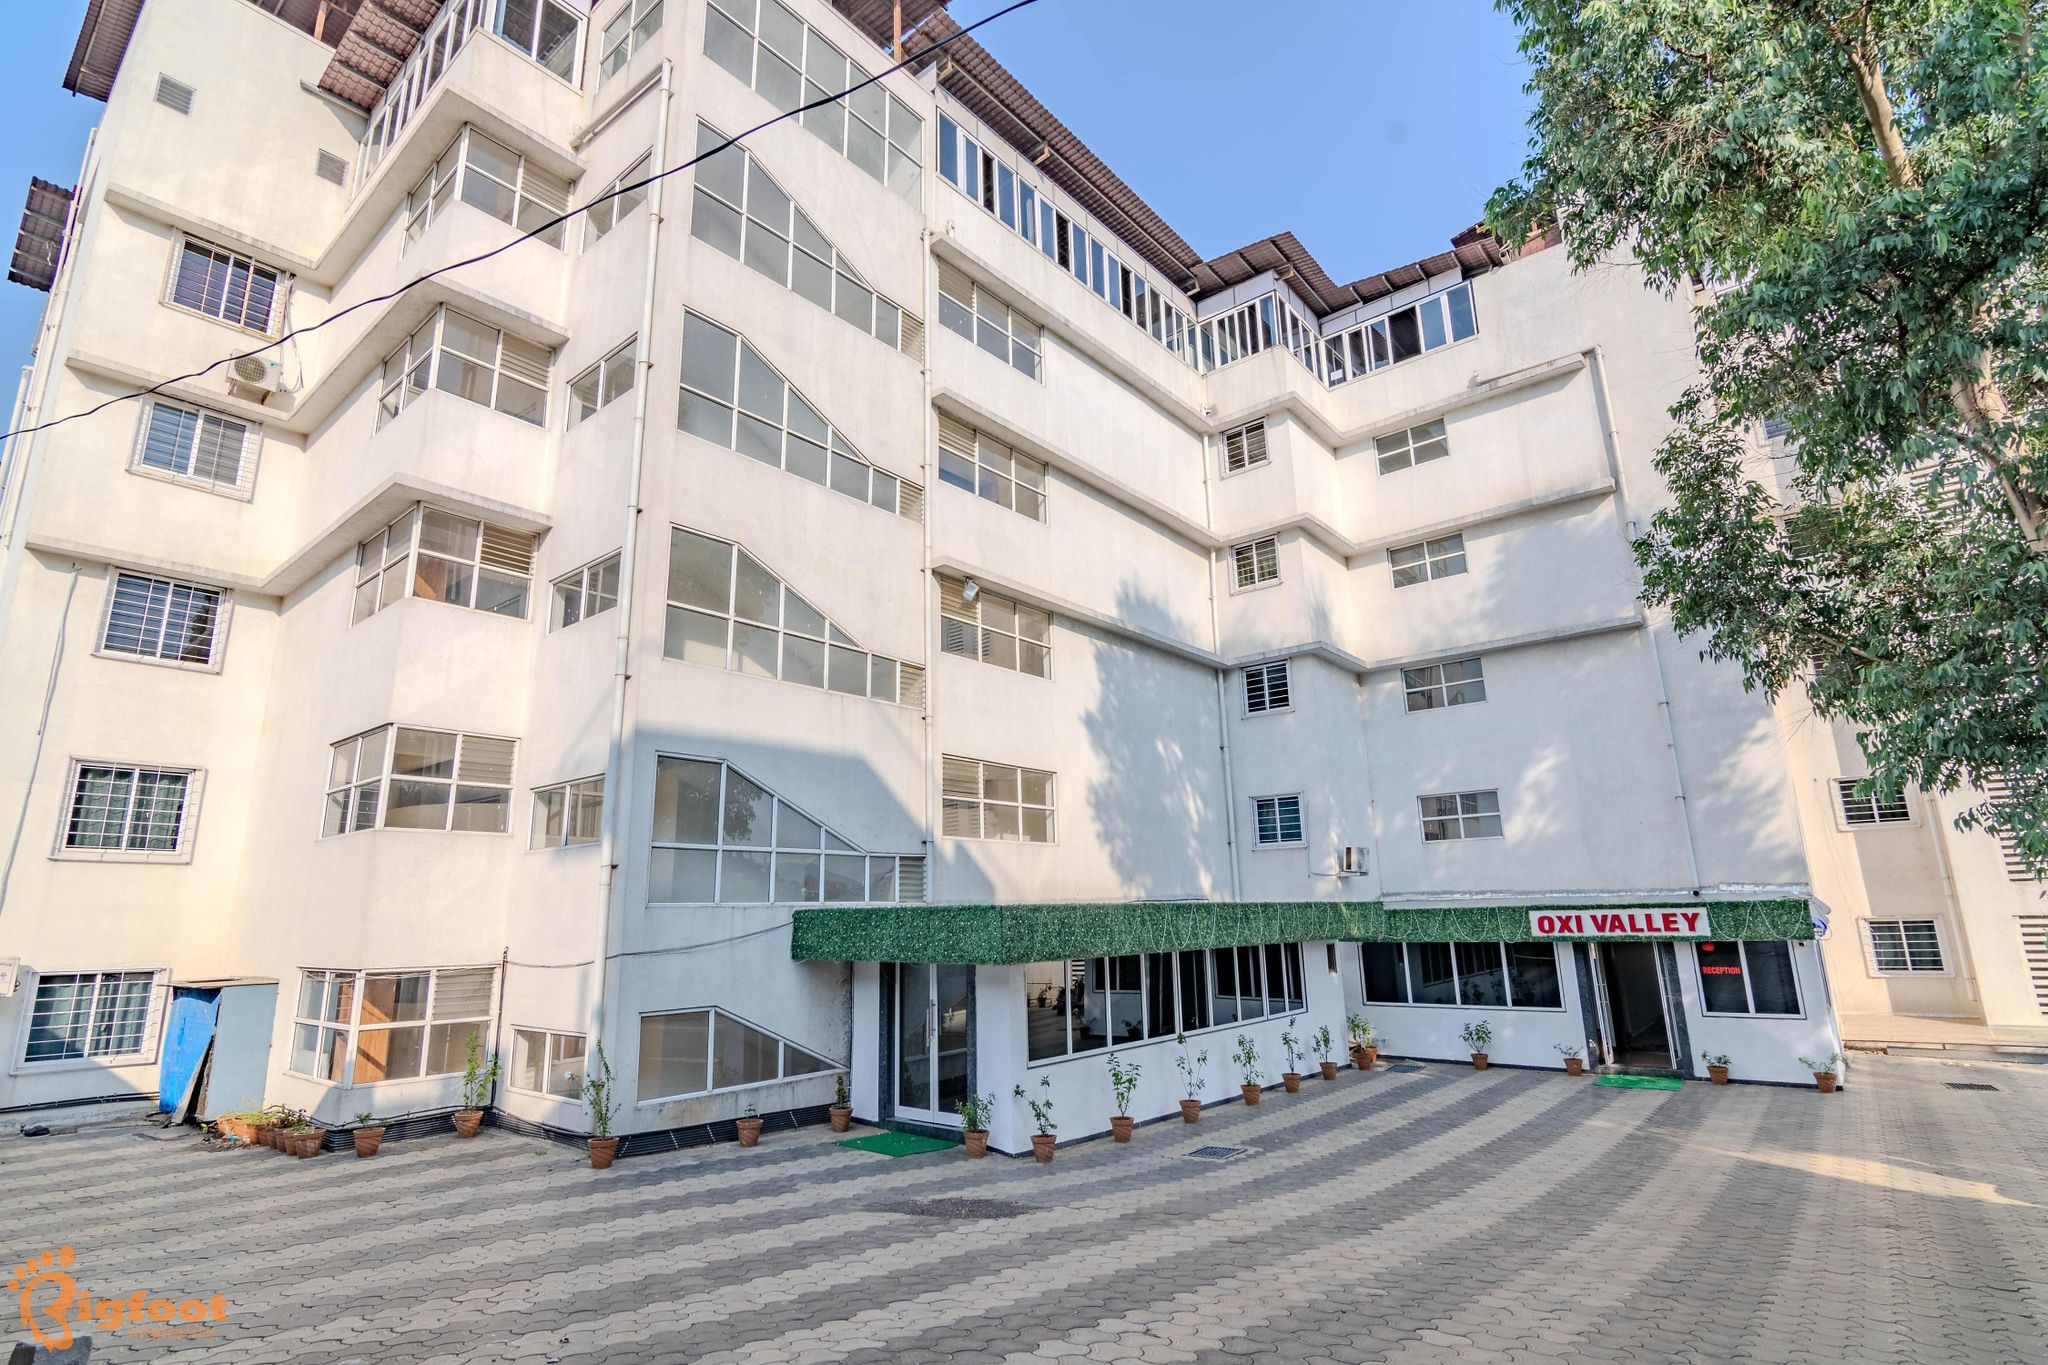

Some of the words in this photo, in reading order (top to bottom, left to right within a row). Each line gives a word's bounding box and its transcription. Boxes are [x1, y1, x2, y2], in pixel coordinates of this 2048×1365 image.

[1537, 915, 1583, 934] OXI
[1590, 912, 1700, 933] VALLEY
[1702, 965, 1741, 975] RECEPTION
